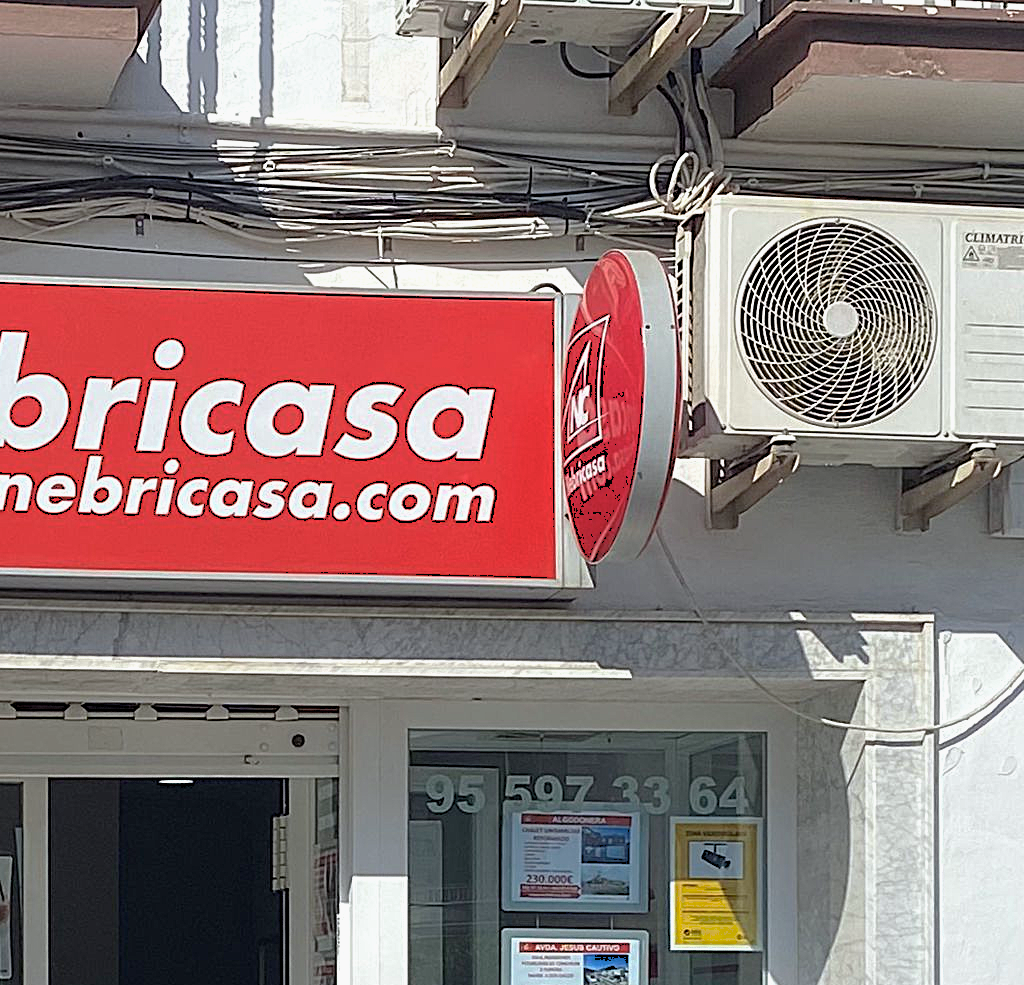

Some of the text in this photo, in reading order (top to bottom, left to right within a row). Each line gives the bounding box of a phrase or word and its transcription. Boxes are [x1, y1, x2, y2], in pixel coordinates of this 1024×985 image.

[426, 774, 750, 816] 95 597 33 64
[526, 875, 574, 884] 230.000€
[586, 944, 620, 952] CAUTIVO
